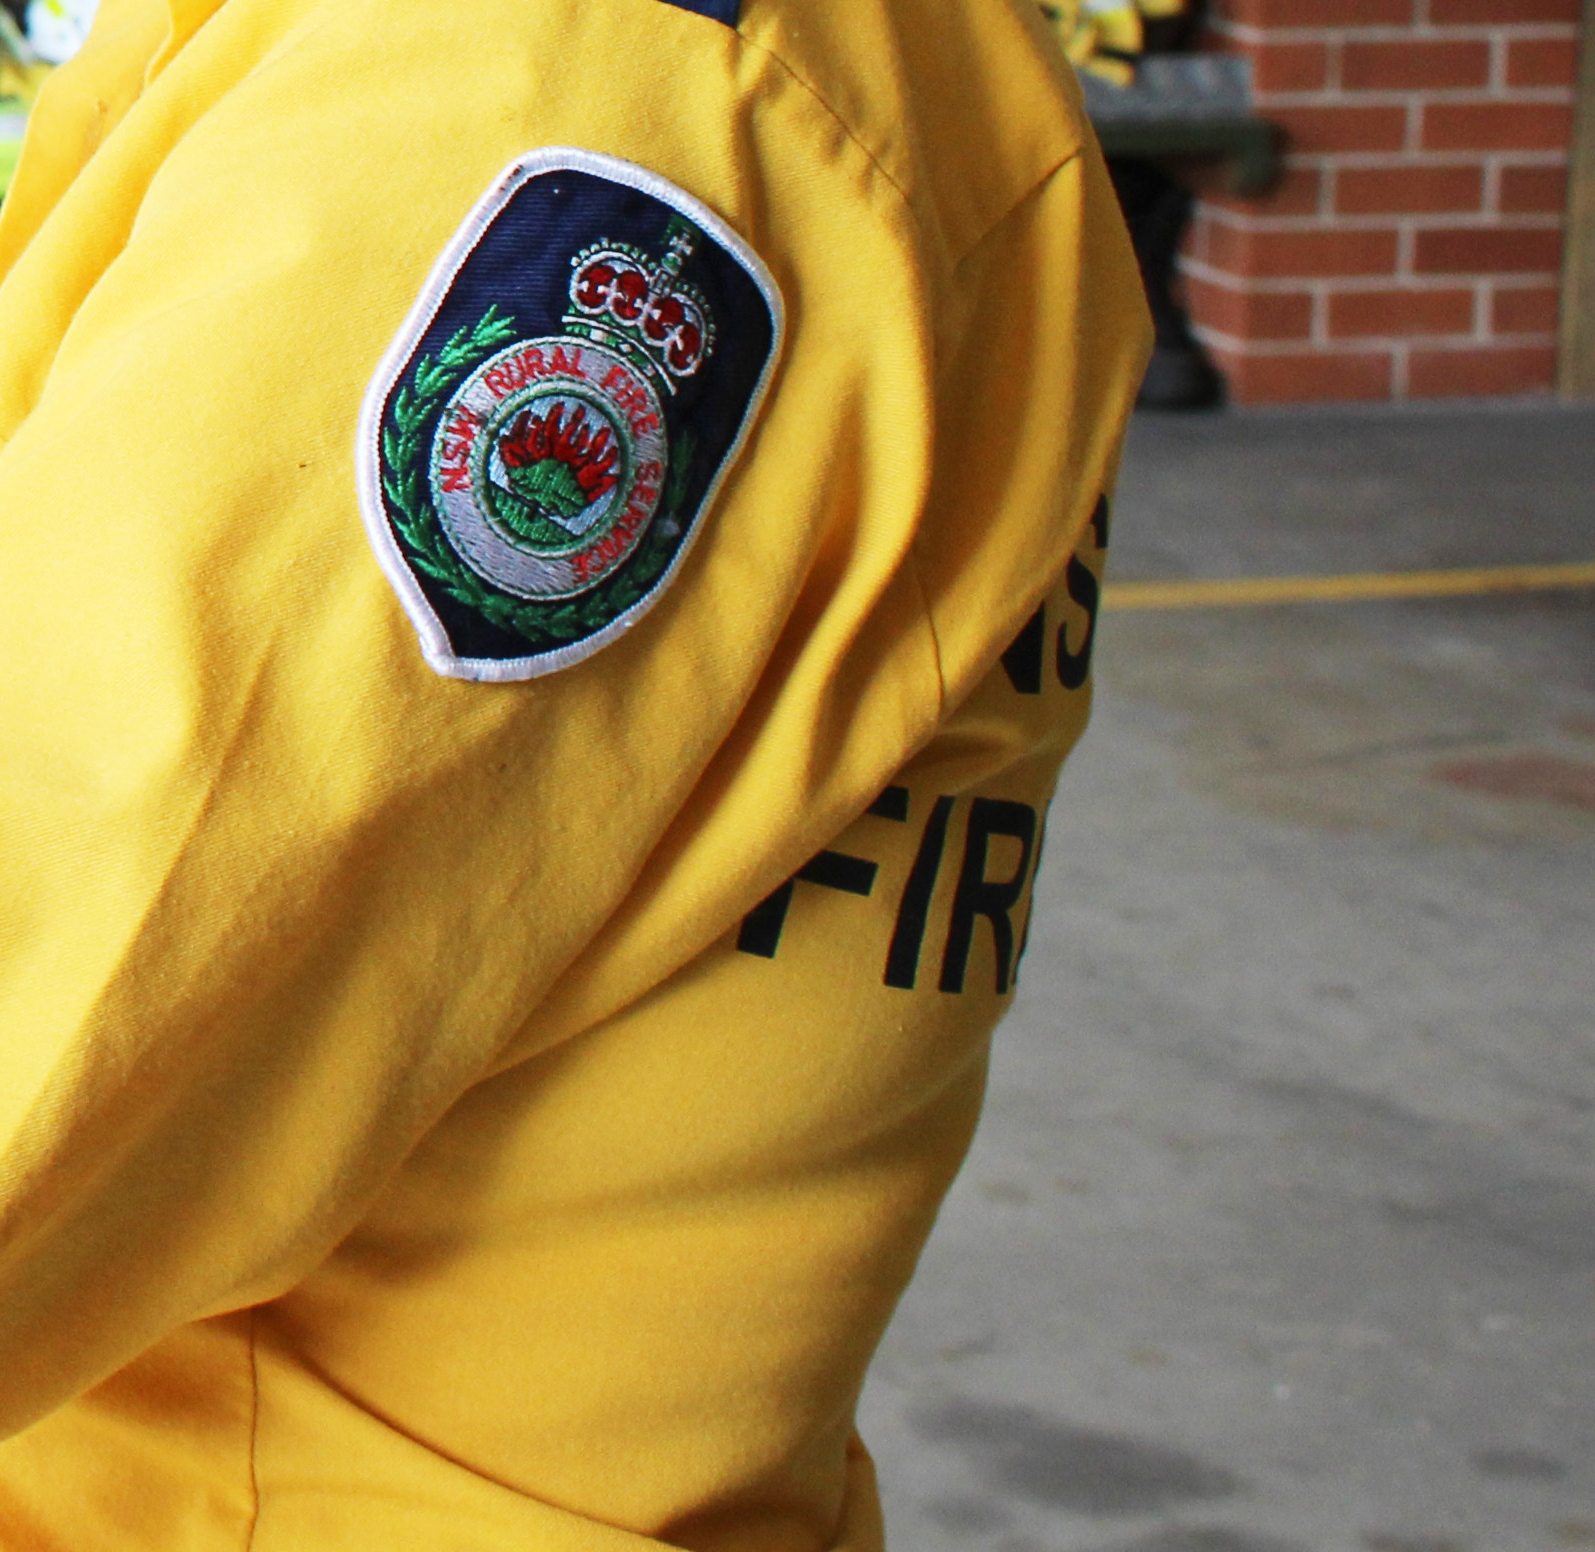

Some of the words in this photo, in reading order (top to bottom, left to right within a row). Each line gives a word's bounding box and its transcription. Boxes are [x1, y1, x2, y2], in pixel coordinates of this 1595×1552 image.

[484, 345, 587, 399] RURAL
[600, 366, 660, 439] FIRE
[440, 405, 480, 493] NSW
[570, 461, 662, 585] SERVICE
[736, 786, 1053, 995] FIR
